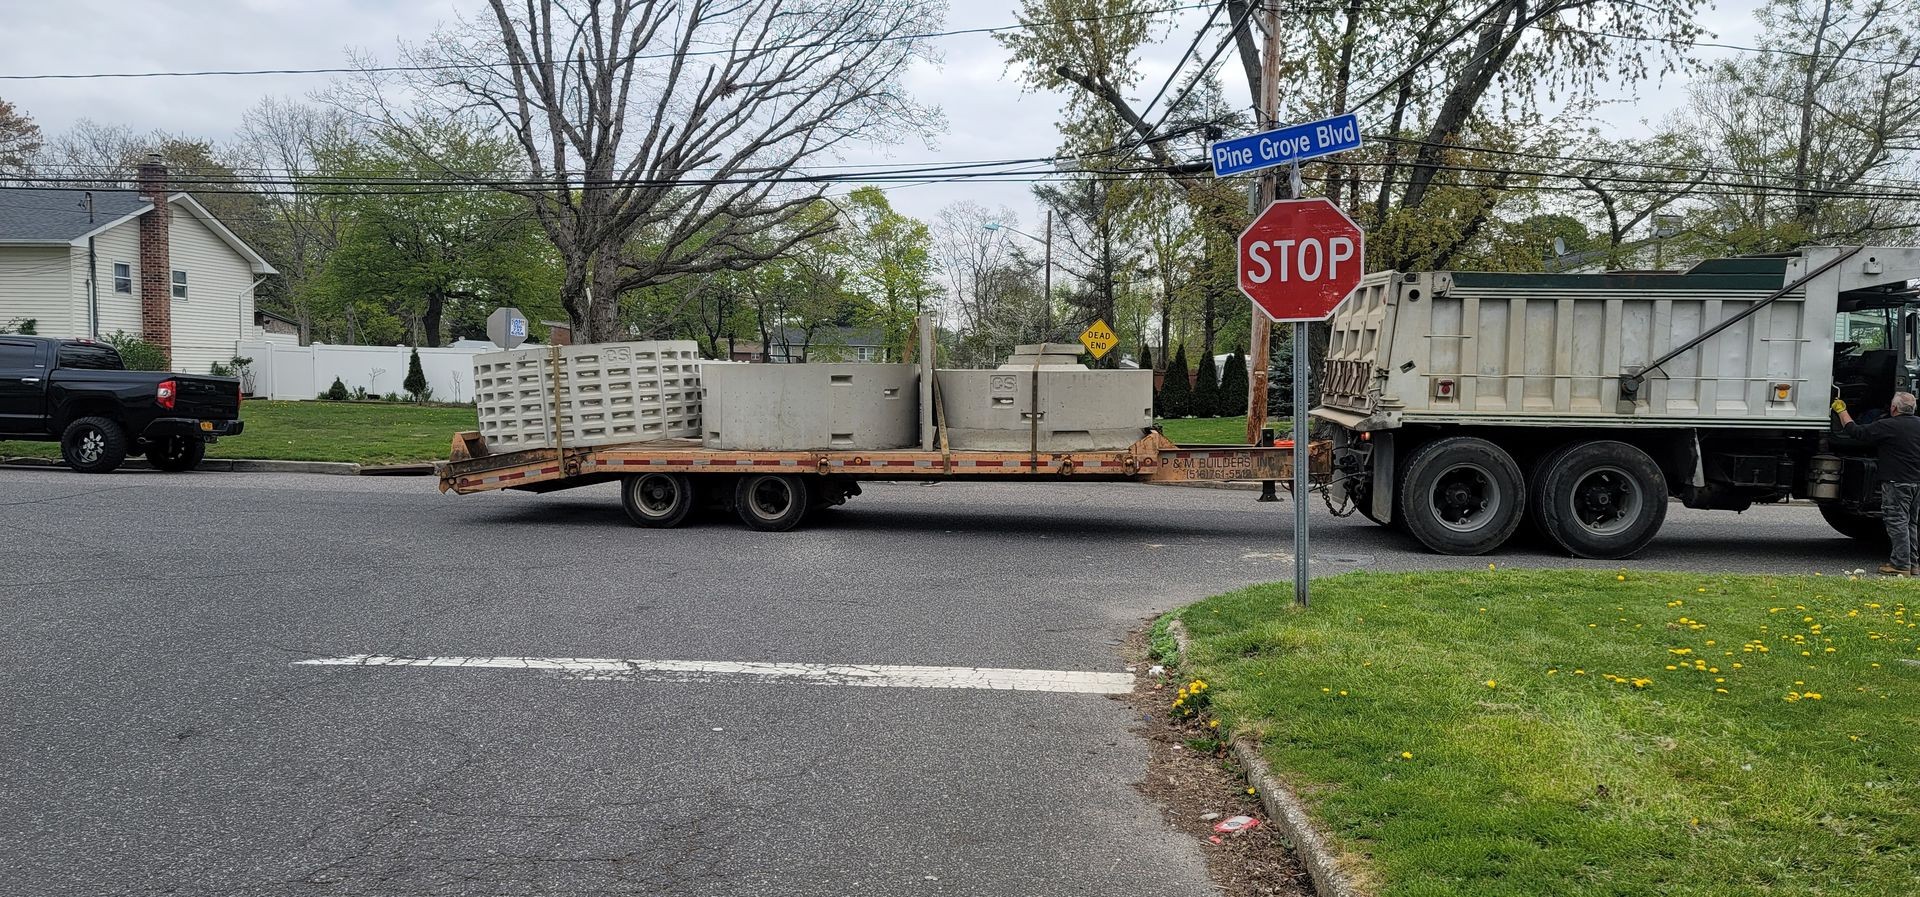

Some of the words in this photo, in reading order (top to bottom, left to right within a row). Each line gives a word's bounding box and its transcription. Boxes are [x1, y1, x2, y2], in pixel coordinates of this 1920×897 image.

[1215, 146, 1253, 170] Pine
[1259, 134, 1311, 161] Grove
[1316, 119, 1356, 149] Blvd
[1247, 236, 1355, 284] STOP
[1088, 331, 1111, 340] DEAD
[1090, 341, 1107, 350] END
[1161, 457, 1169, 468] P
[1173, 458, 1181, 469] &
[1184, 458, 1194, 468] M
